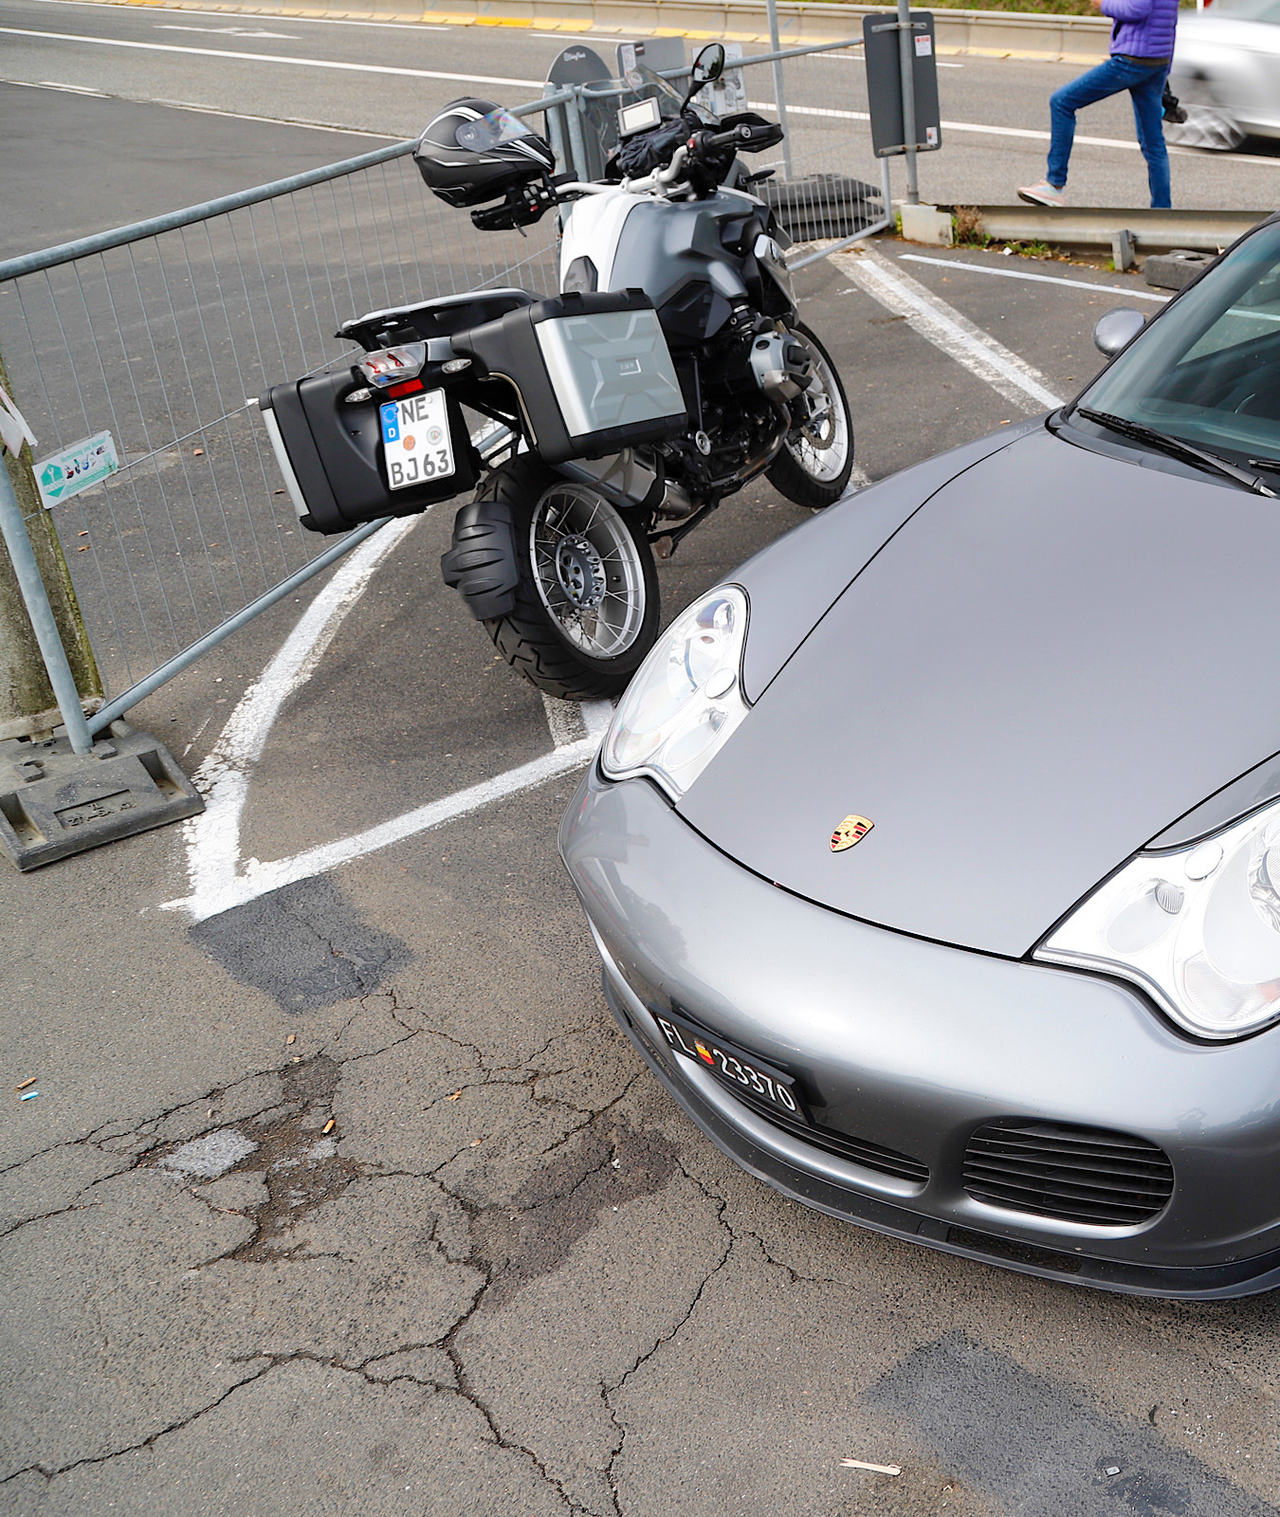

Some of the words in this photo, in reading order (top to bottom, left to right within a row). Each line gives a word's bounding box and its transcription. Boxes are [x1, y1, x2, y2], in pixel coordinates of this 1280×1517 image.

[401, 397, 429, 426] NE
[388, 428, 396, 438] D
[658, 1016, 697, 1057] FL
[712, 1048, 797, 1112] 23370
